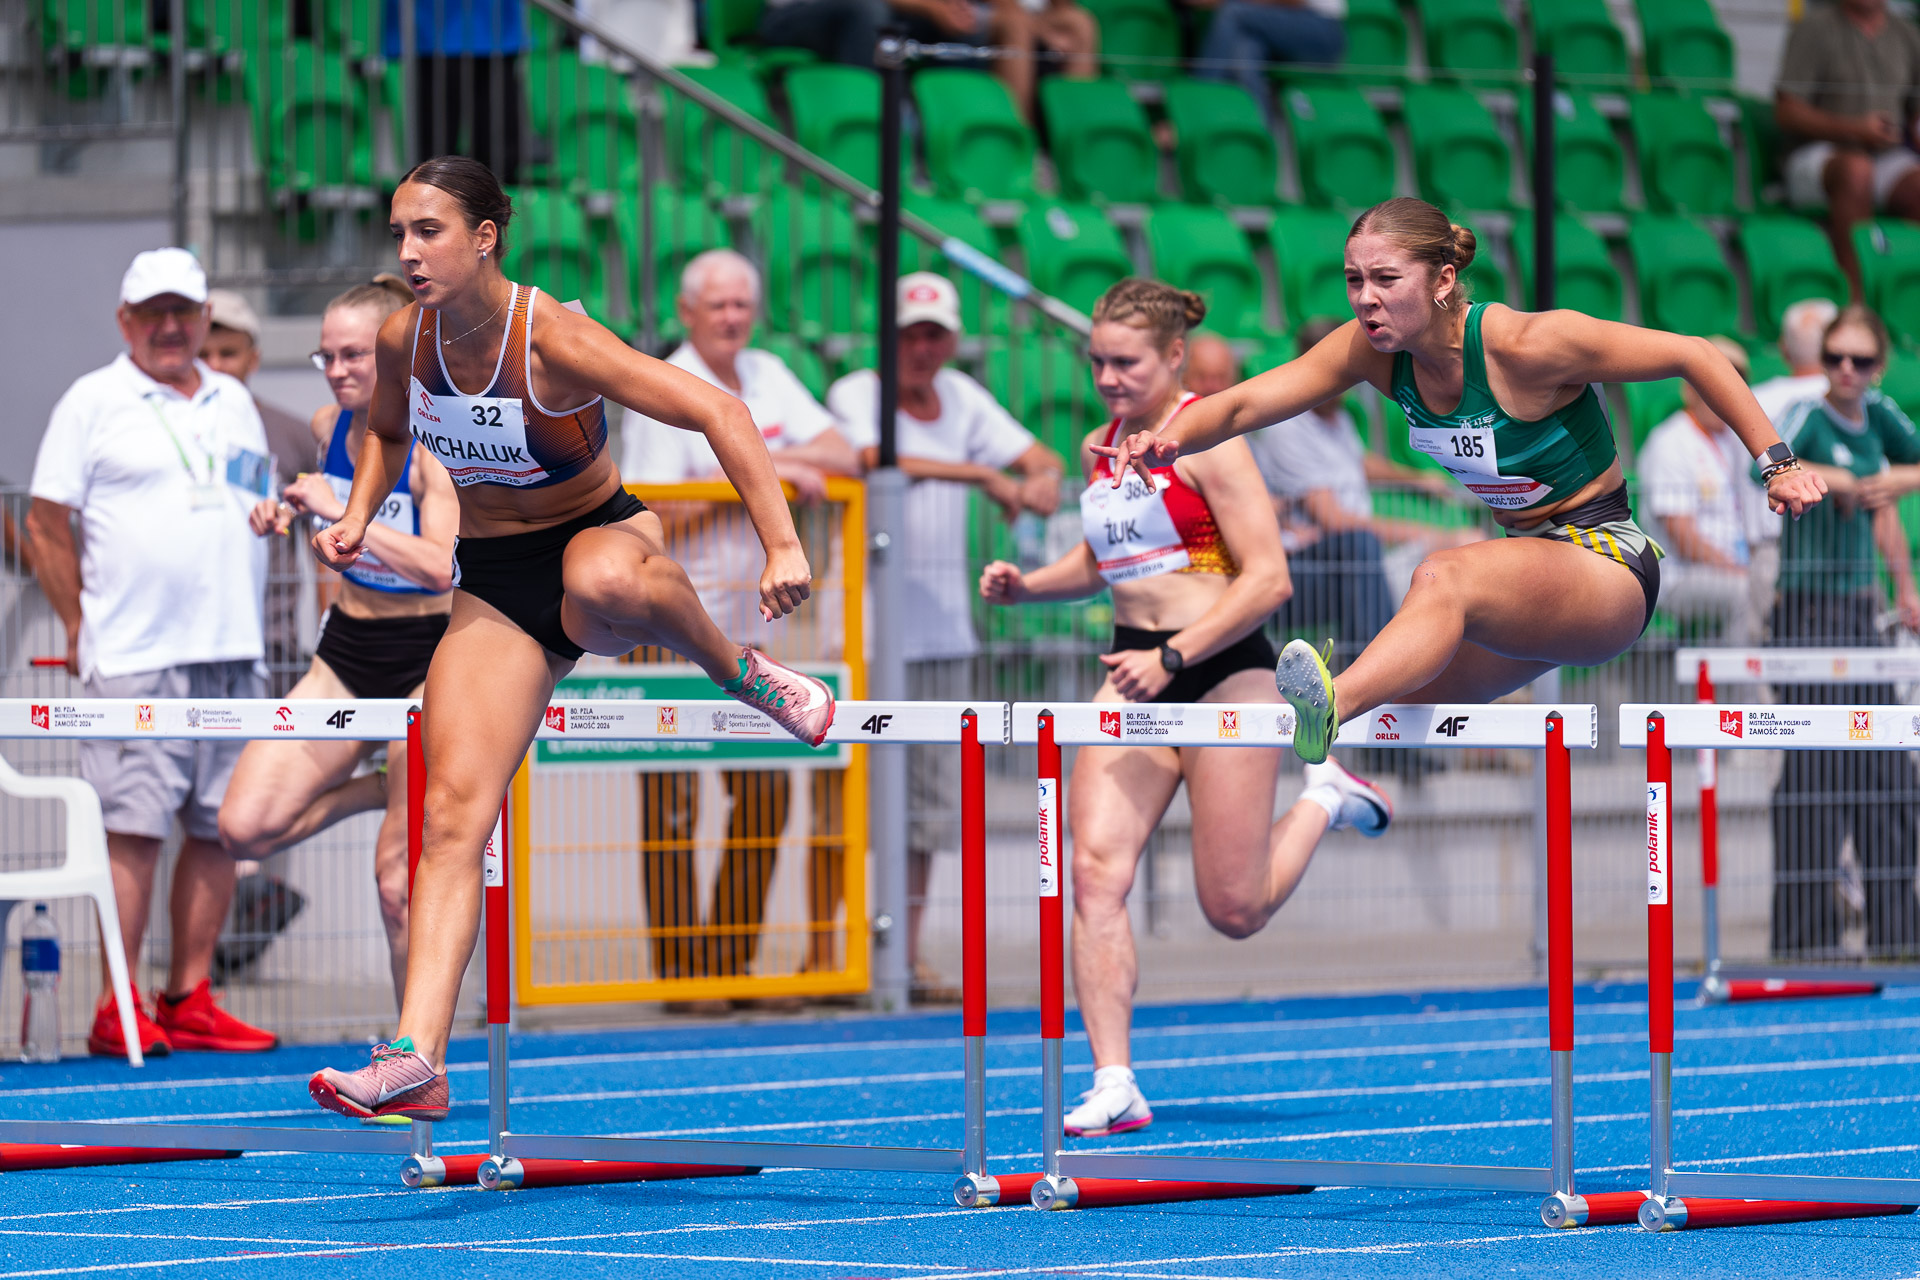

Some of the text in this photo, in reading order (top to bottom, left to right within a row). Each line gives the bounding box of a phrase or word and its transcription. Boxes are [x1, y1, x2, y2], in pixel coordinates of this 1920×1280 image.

[417, 407, 441, 423] ORLEN
[471, 405, 503, 427] 32
[413, 424, 530, 464] MICHALUK
[1450, 435, 1484, 458] 185
[455, 473, 492, 485] MOŚĆ
[1481, 495, 1528, 506] AMOŚĆ 2026
[1104, 517, 1142, 545] ŻUK
[202, 716, 218, 724] Sportu
[221, 716, 242, 724] Turystyki
[326, 709, 356, 729] 4F
[1748, 712, 1776, 720] 80. PZLA
[54, 719, 78, 727] ZAMOŚĆ
[570, 721, 596, 730] ZAMOŚĆ
[729, 720, 745, 729] Sportu
[749, 720, 771, 729] Turystyki
[861, 714, 893, 734] 4F
[1436, 716, 1469, 737] 4F
[658, 725, 677, 734] PZLA
[1126, 726, 1153, 735] ZAMOŚĆ
[1219, 729, 1239, 738] PZLA
[1749, 726, 1778, 735] ZAMOŚĆ
[1850, 731, 1871, 739] PZLA
[1375, 732, 1400, 741] ORLEN
[1039, 807, 1052, 867] polanik
[1647, 811, 1662, 874] polanik
